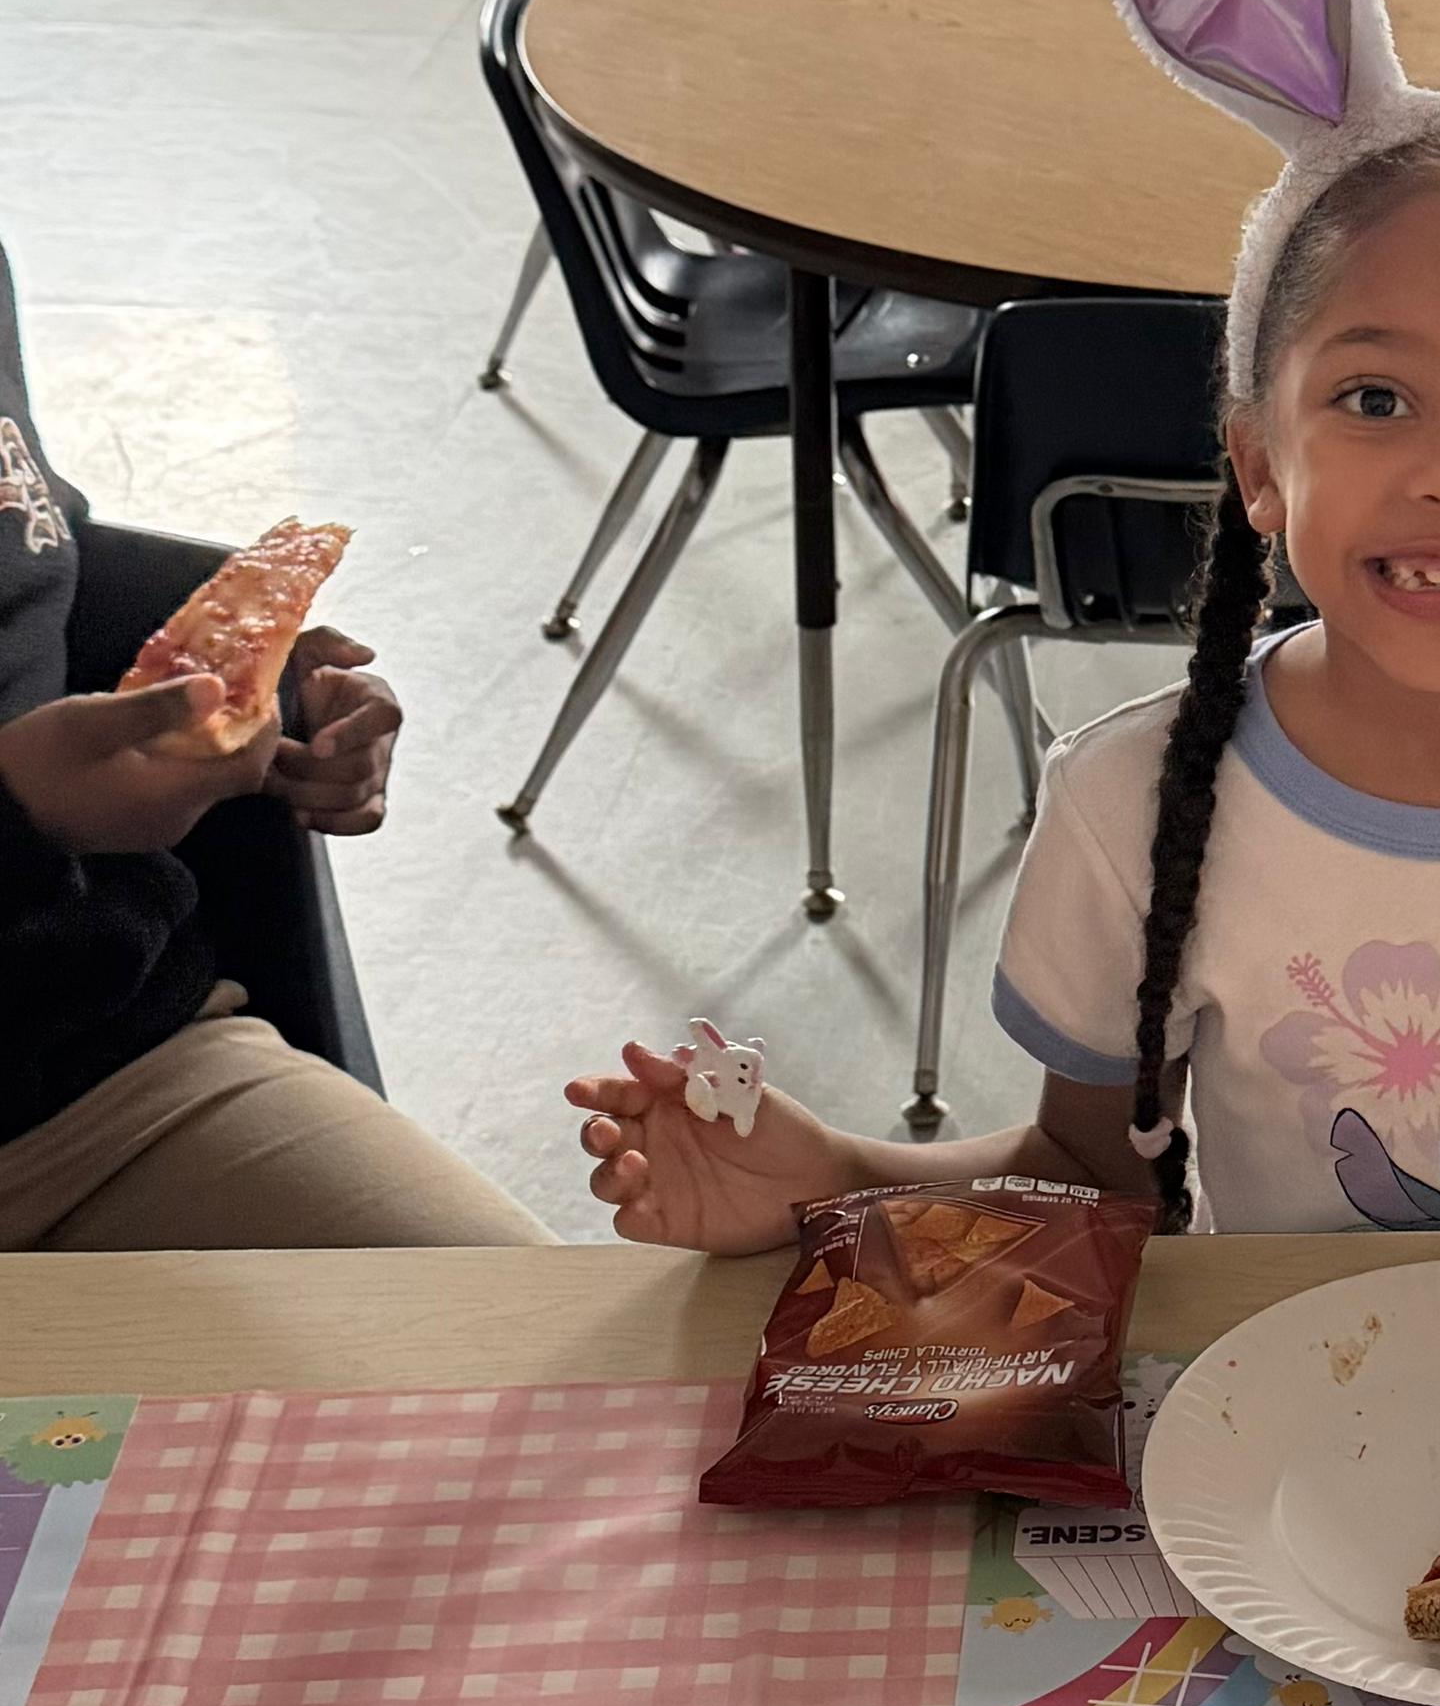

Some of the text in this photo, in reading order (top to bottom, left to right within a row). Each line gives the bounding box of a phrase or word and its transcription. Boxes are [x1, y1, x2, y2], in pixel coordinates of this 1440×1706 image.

[787, 1348, 1055, 1376] ARTIFICIALLY FLAVORED
[863, 1346, 986, 1361] TORTILLA CHIPS
[764, 1360, 1076, 1398] NACHO CHEESE
[864, 1400, 958, 1419] Clancy's
[1022, 1524, 1147, 1545] SCENE.
